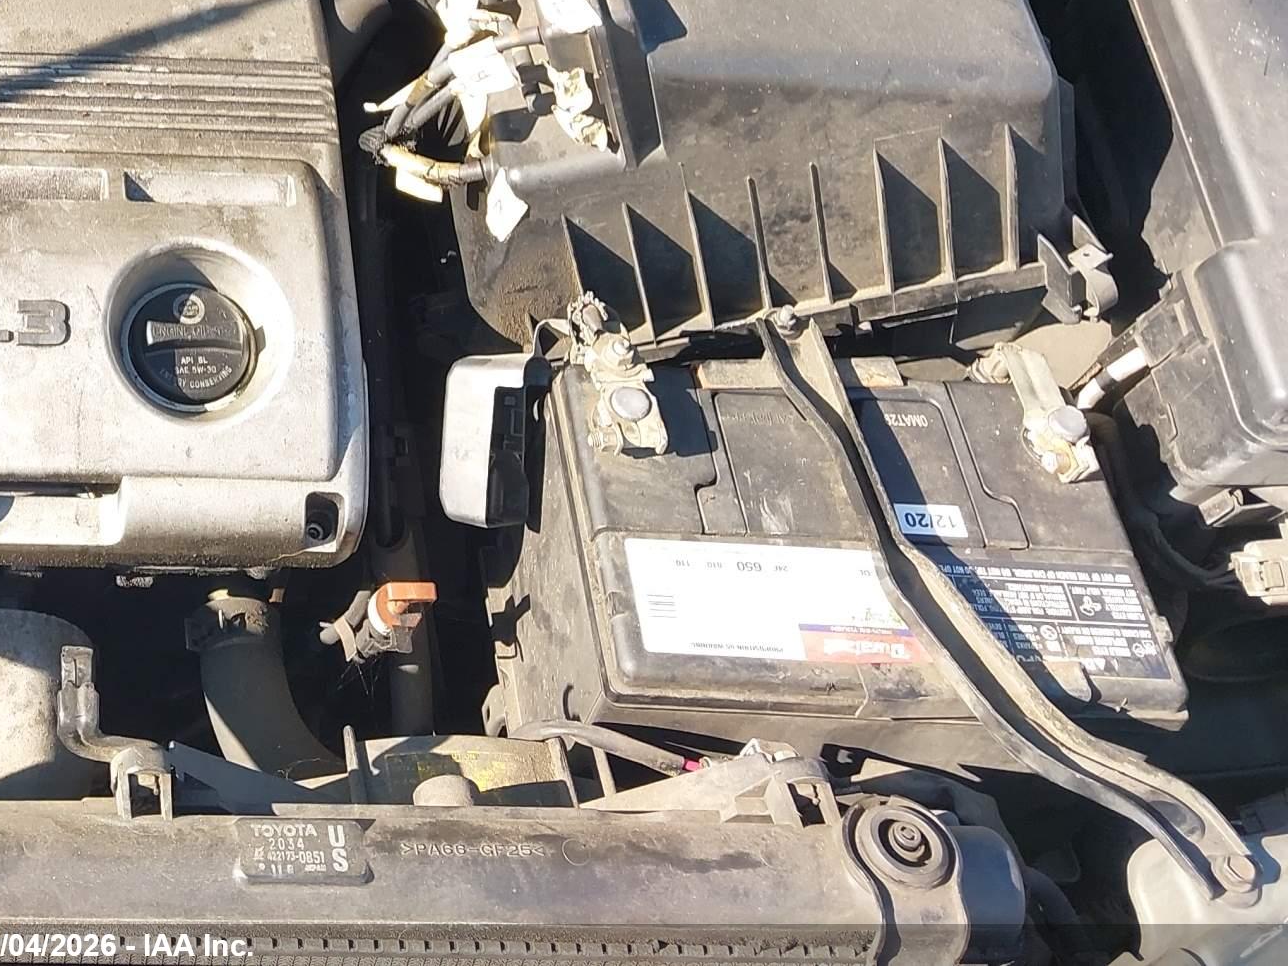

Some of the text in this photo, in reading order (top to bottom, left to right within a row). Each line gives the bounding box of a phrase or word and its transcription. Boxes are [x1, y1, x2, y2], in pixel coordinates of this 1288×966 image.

[904, 513, 956, 529] 12/20
[737, 561, 762, 573] 650
[251, 824, 317, 837] TOYOTA
[269, 837, 304, 850] 2034
